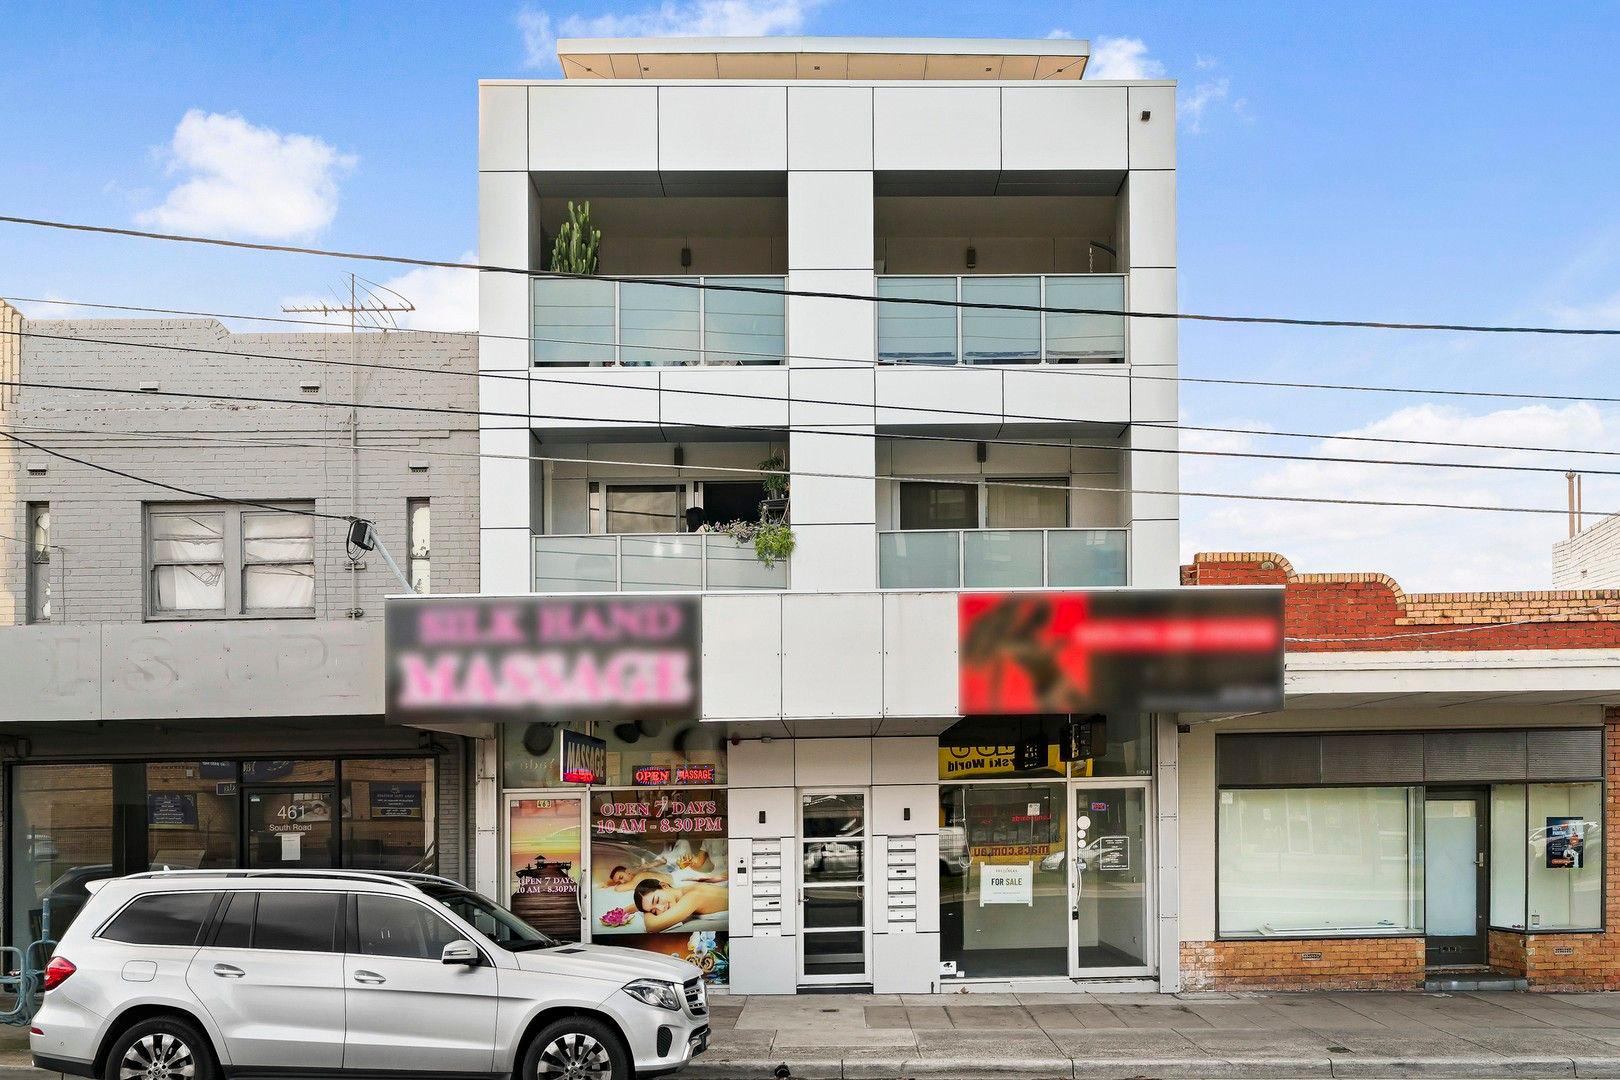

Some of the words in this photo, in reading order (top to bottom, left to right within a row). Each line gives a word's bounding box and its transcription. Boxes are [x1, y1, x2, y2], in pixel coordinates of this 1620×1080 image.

[566, 741, 605, 779] MASSAGE
[636, 771, 670, 782] OPEN
[679, 769, 714, 781] MASSAGE
[277, 805, 305, 820] 461
[600, 802, 652, 817] OPEN
[654, 800, 669, 818] 7
[672, 800, 717, 815] DAYS
[269, 823, 291, 832] South
[292, 823, 312, 832] Road
[597, 819, 616, 834] 10
[620, 818, 647, 834] AM
[518, 876, 542, 885] OPEN
[544, 877, 551, 885] 7
[991, 878, 1004, 886] FOR
[1005, 877, 1023, 886] SALE
